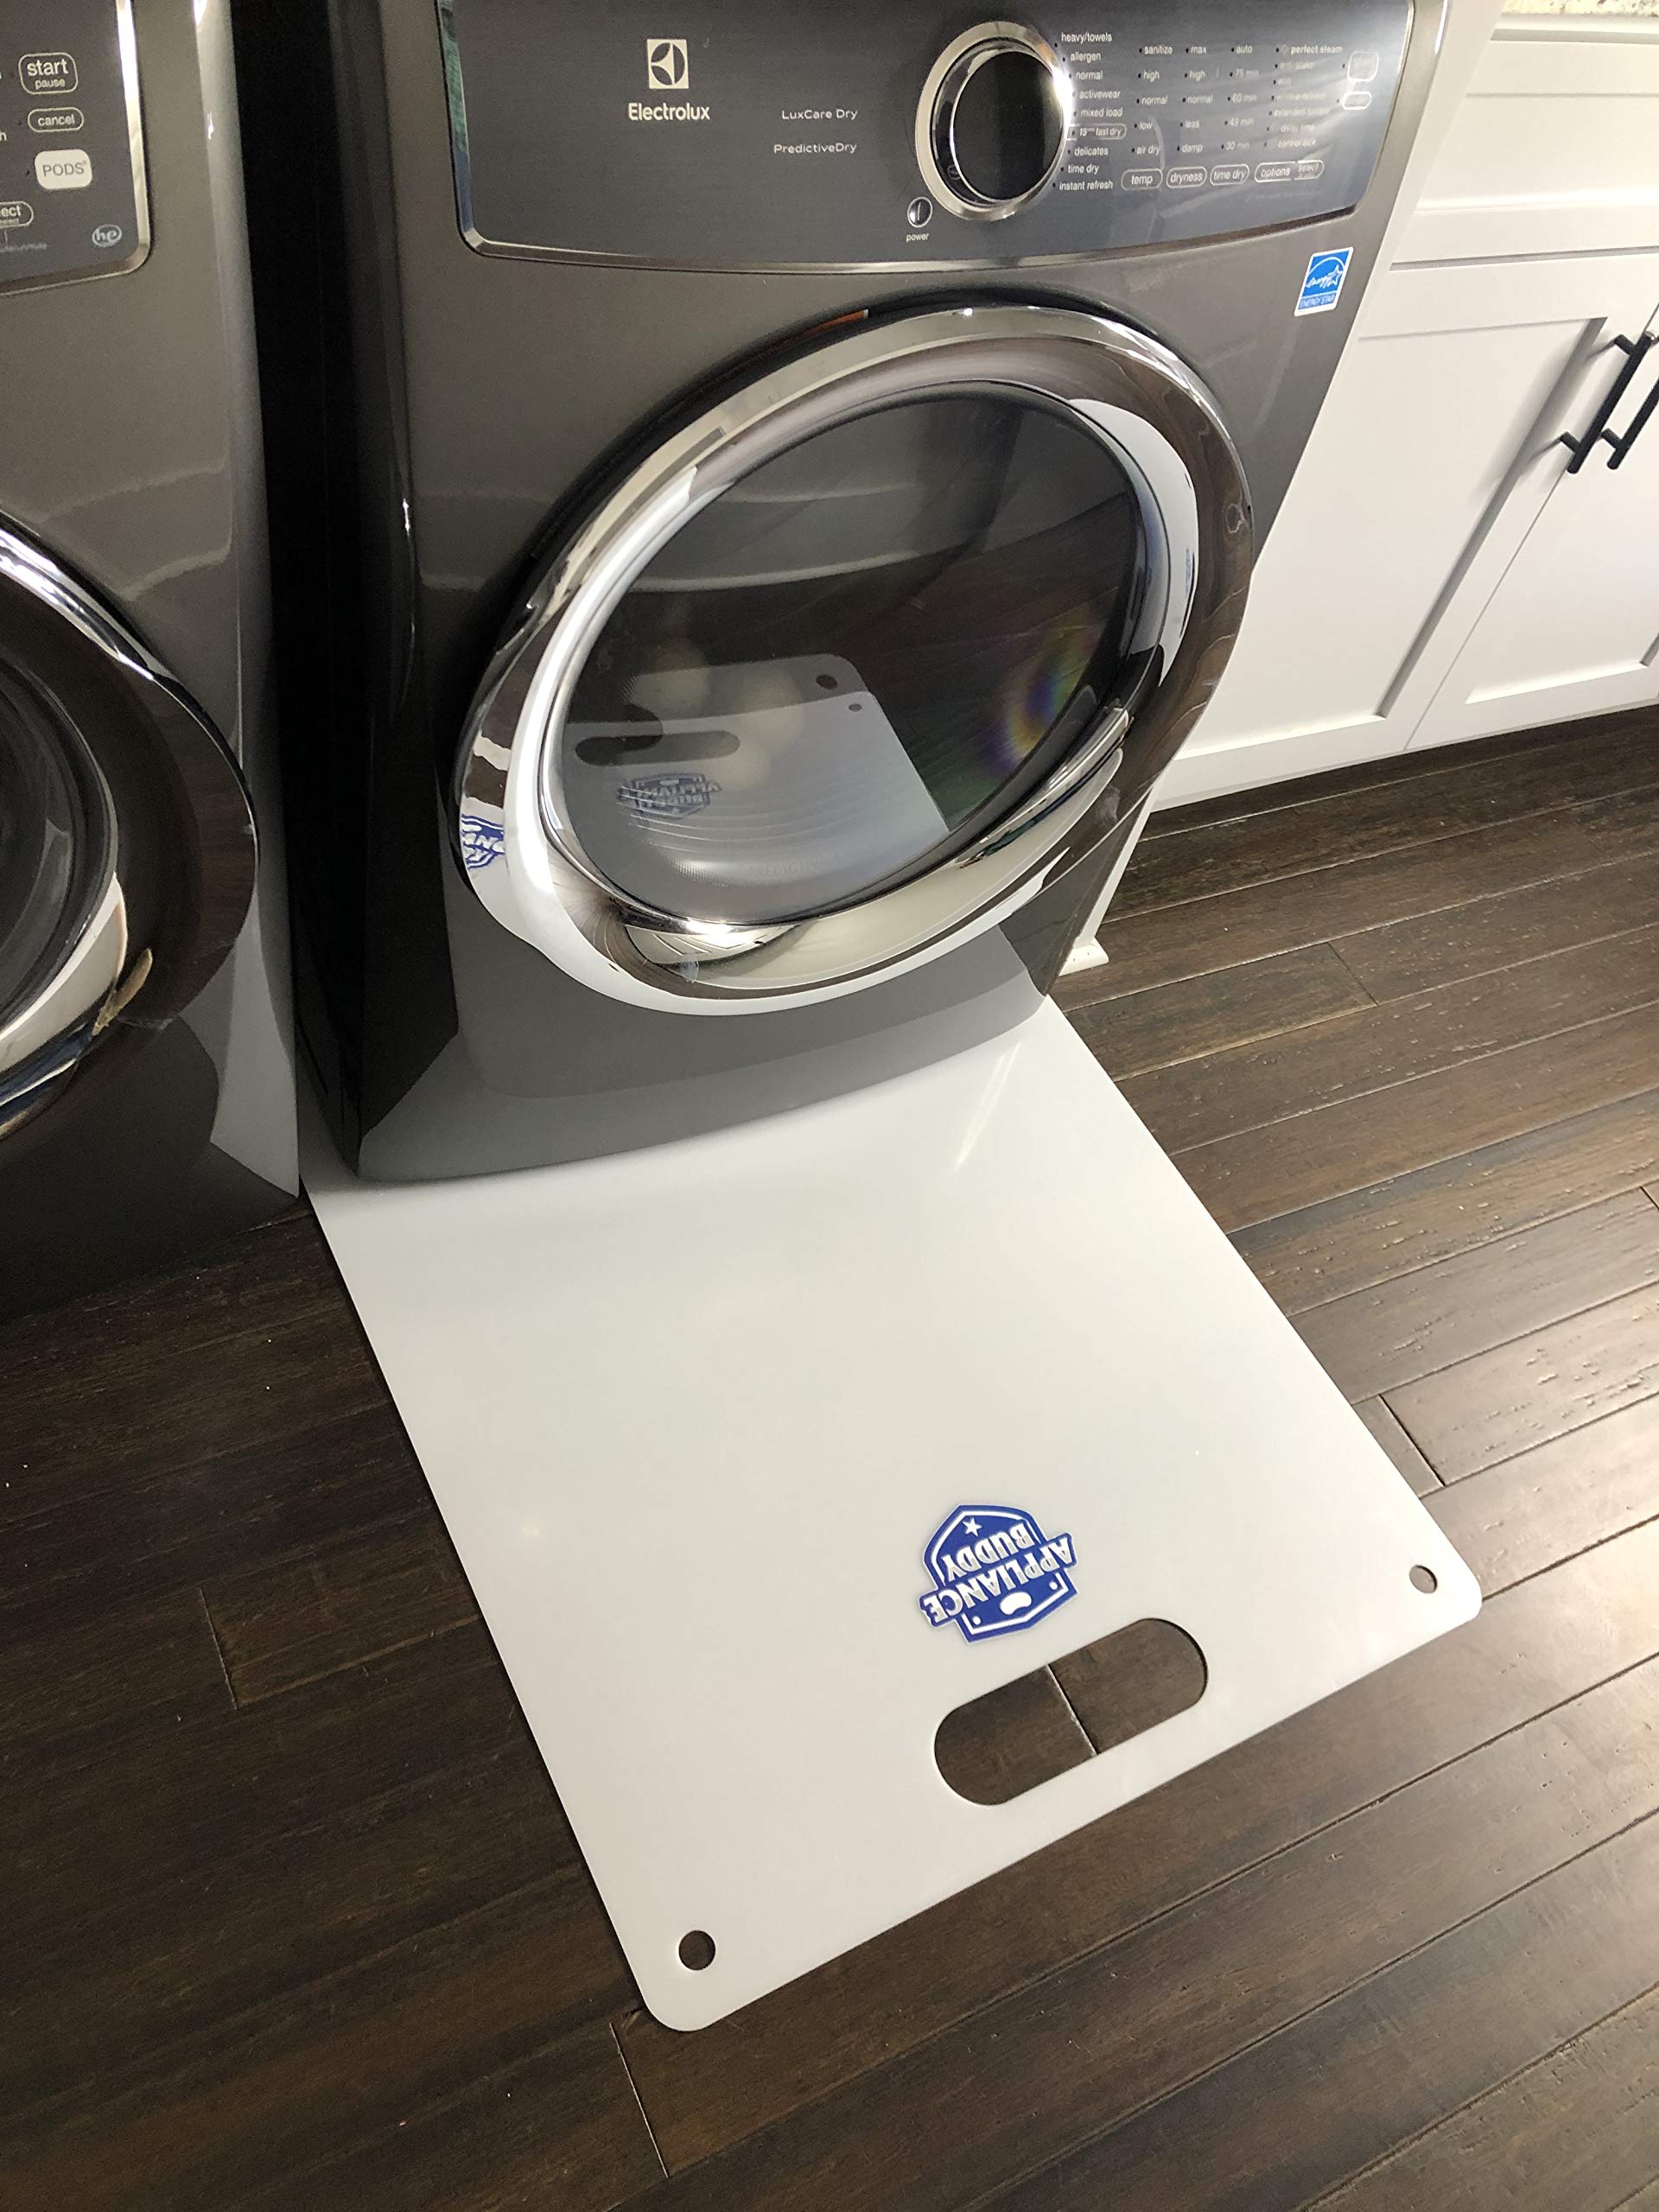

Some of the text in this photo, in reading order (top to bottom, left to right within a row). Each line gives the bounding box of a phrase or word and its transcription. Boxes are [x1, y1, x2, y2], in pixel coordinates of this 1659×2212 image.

[1061, 32, 1113, 44] heavy/towels
[1144, 45, 1173, 54] sanitize
[1191, 46, 1207, 54] max
[1236, 45, 1253, 54] auto
[1291, 44, 1318, 55] perfect
[1070, 52, 1102, 63] allergen
[27, 58, 69, 76] start
[1076, 70, 1103, 79] normal
[1143, 70, 1160, 82] high
[1189, 70, 1206, 82] high
[1245, 69, 1259, 78] min
[35, 79, 66, 90] pause
[1079, 89, 1121, 99] activewear
[1141, 94, 1168, 105] normal
[1187, 94, 1214, 104] normal
[1232, 92, 1257, 103] 60 min
[628, 102, 711, 121] Electrolux
[781, 108, 859, 121] LuxCare Dry
[1080, 106, 1123, 118] mixed load
[37, 113, 75, 127] cancel
[1140, 120, 1153, 130] low
[773, 143, 858, 155] PredictiveDry
[1074, 146, 1109, 156] delicates
[1136, 144, 1161, 156] air dry
[1181, 143, 1203, 155] damp
[1067, 162, 1100, 175] time dry
[1260, 167, 1291, 180] options
[1170, 172, 1204, 183] dryness
[1213, 168, 1246, 181] time dry
[1058, 180, 1114, 191] instant refresh
[1131, 174, 1154, 187] temp
[906, 232, 930, 243] power
[942, 1523, 1035, 1582] BUDDY
[924, 1537, 1072, 1623] APPLIANCE
